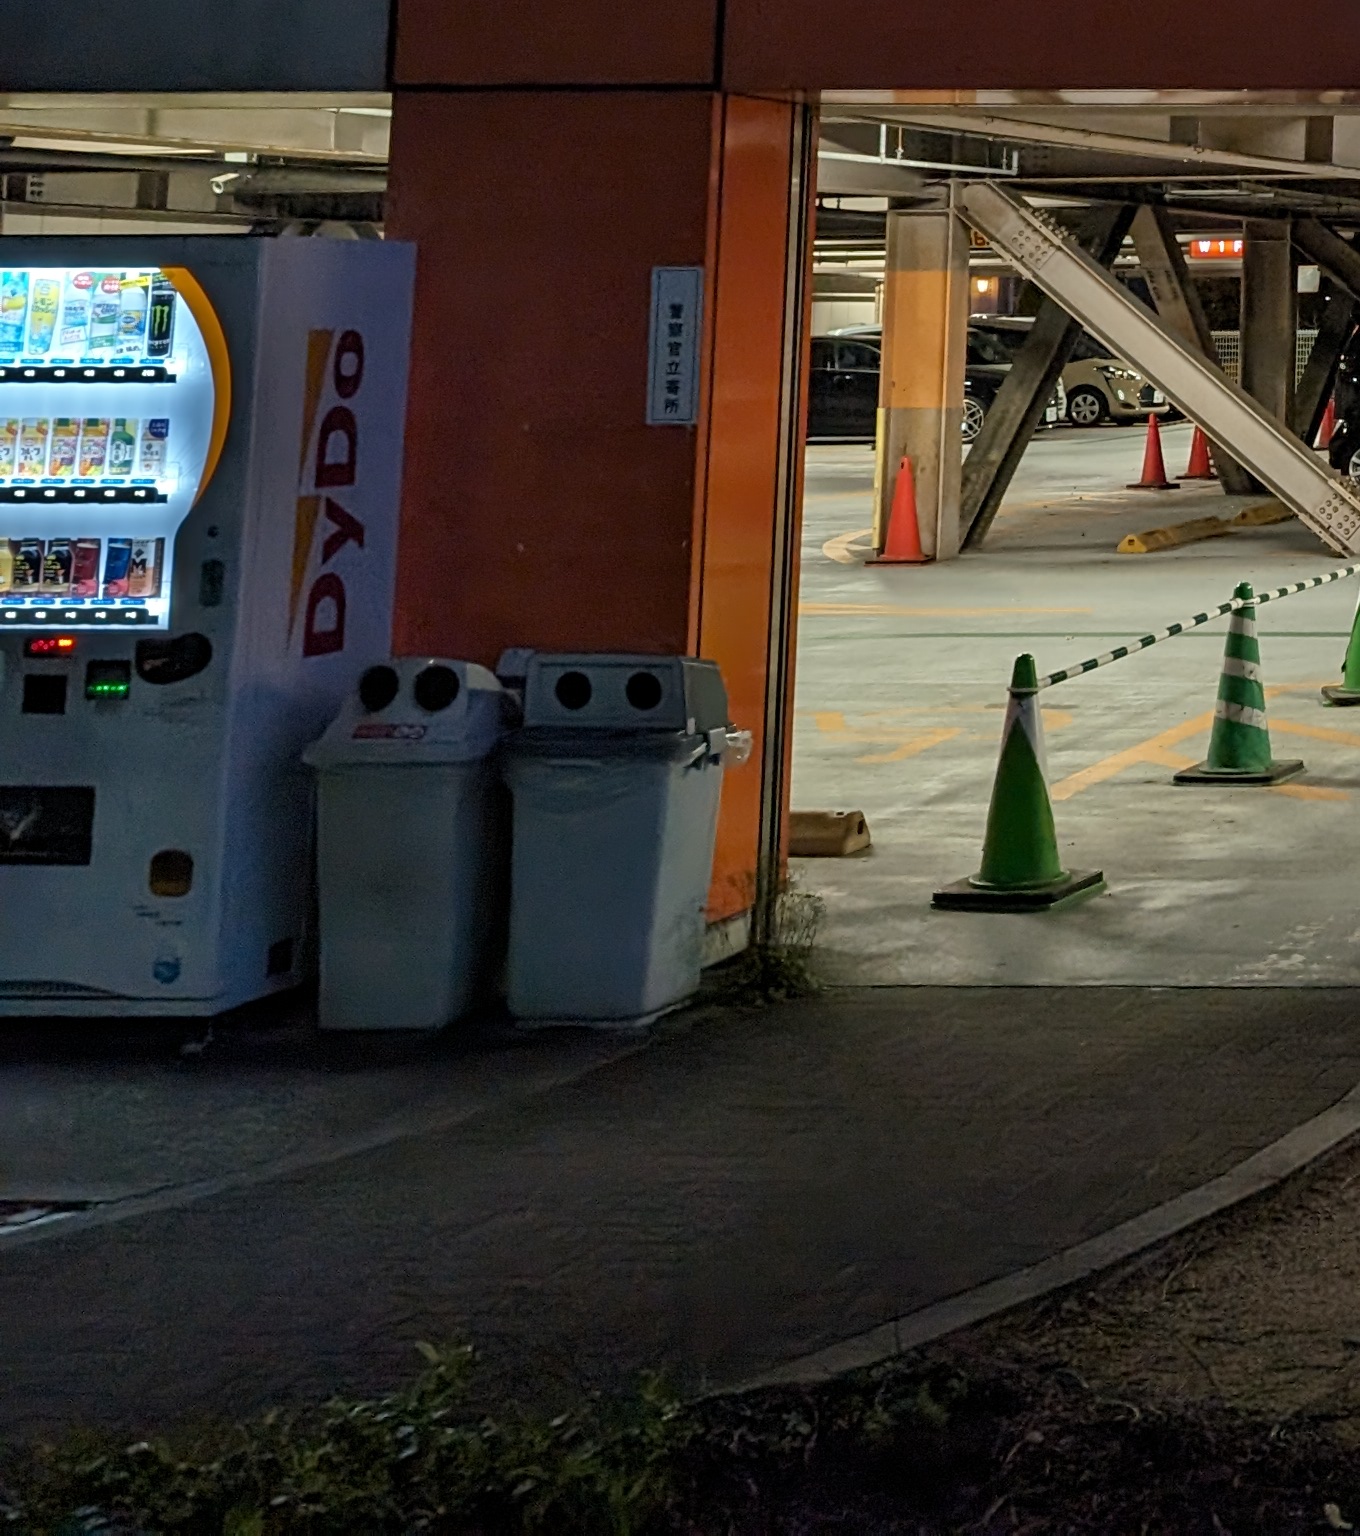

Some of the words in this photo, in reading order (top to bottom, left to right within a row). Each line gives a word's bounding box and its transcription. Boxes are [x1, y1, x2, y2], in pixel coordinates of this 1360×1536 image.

[664, 302, 684, 415] 警察官立寄所
